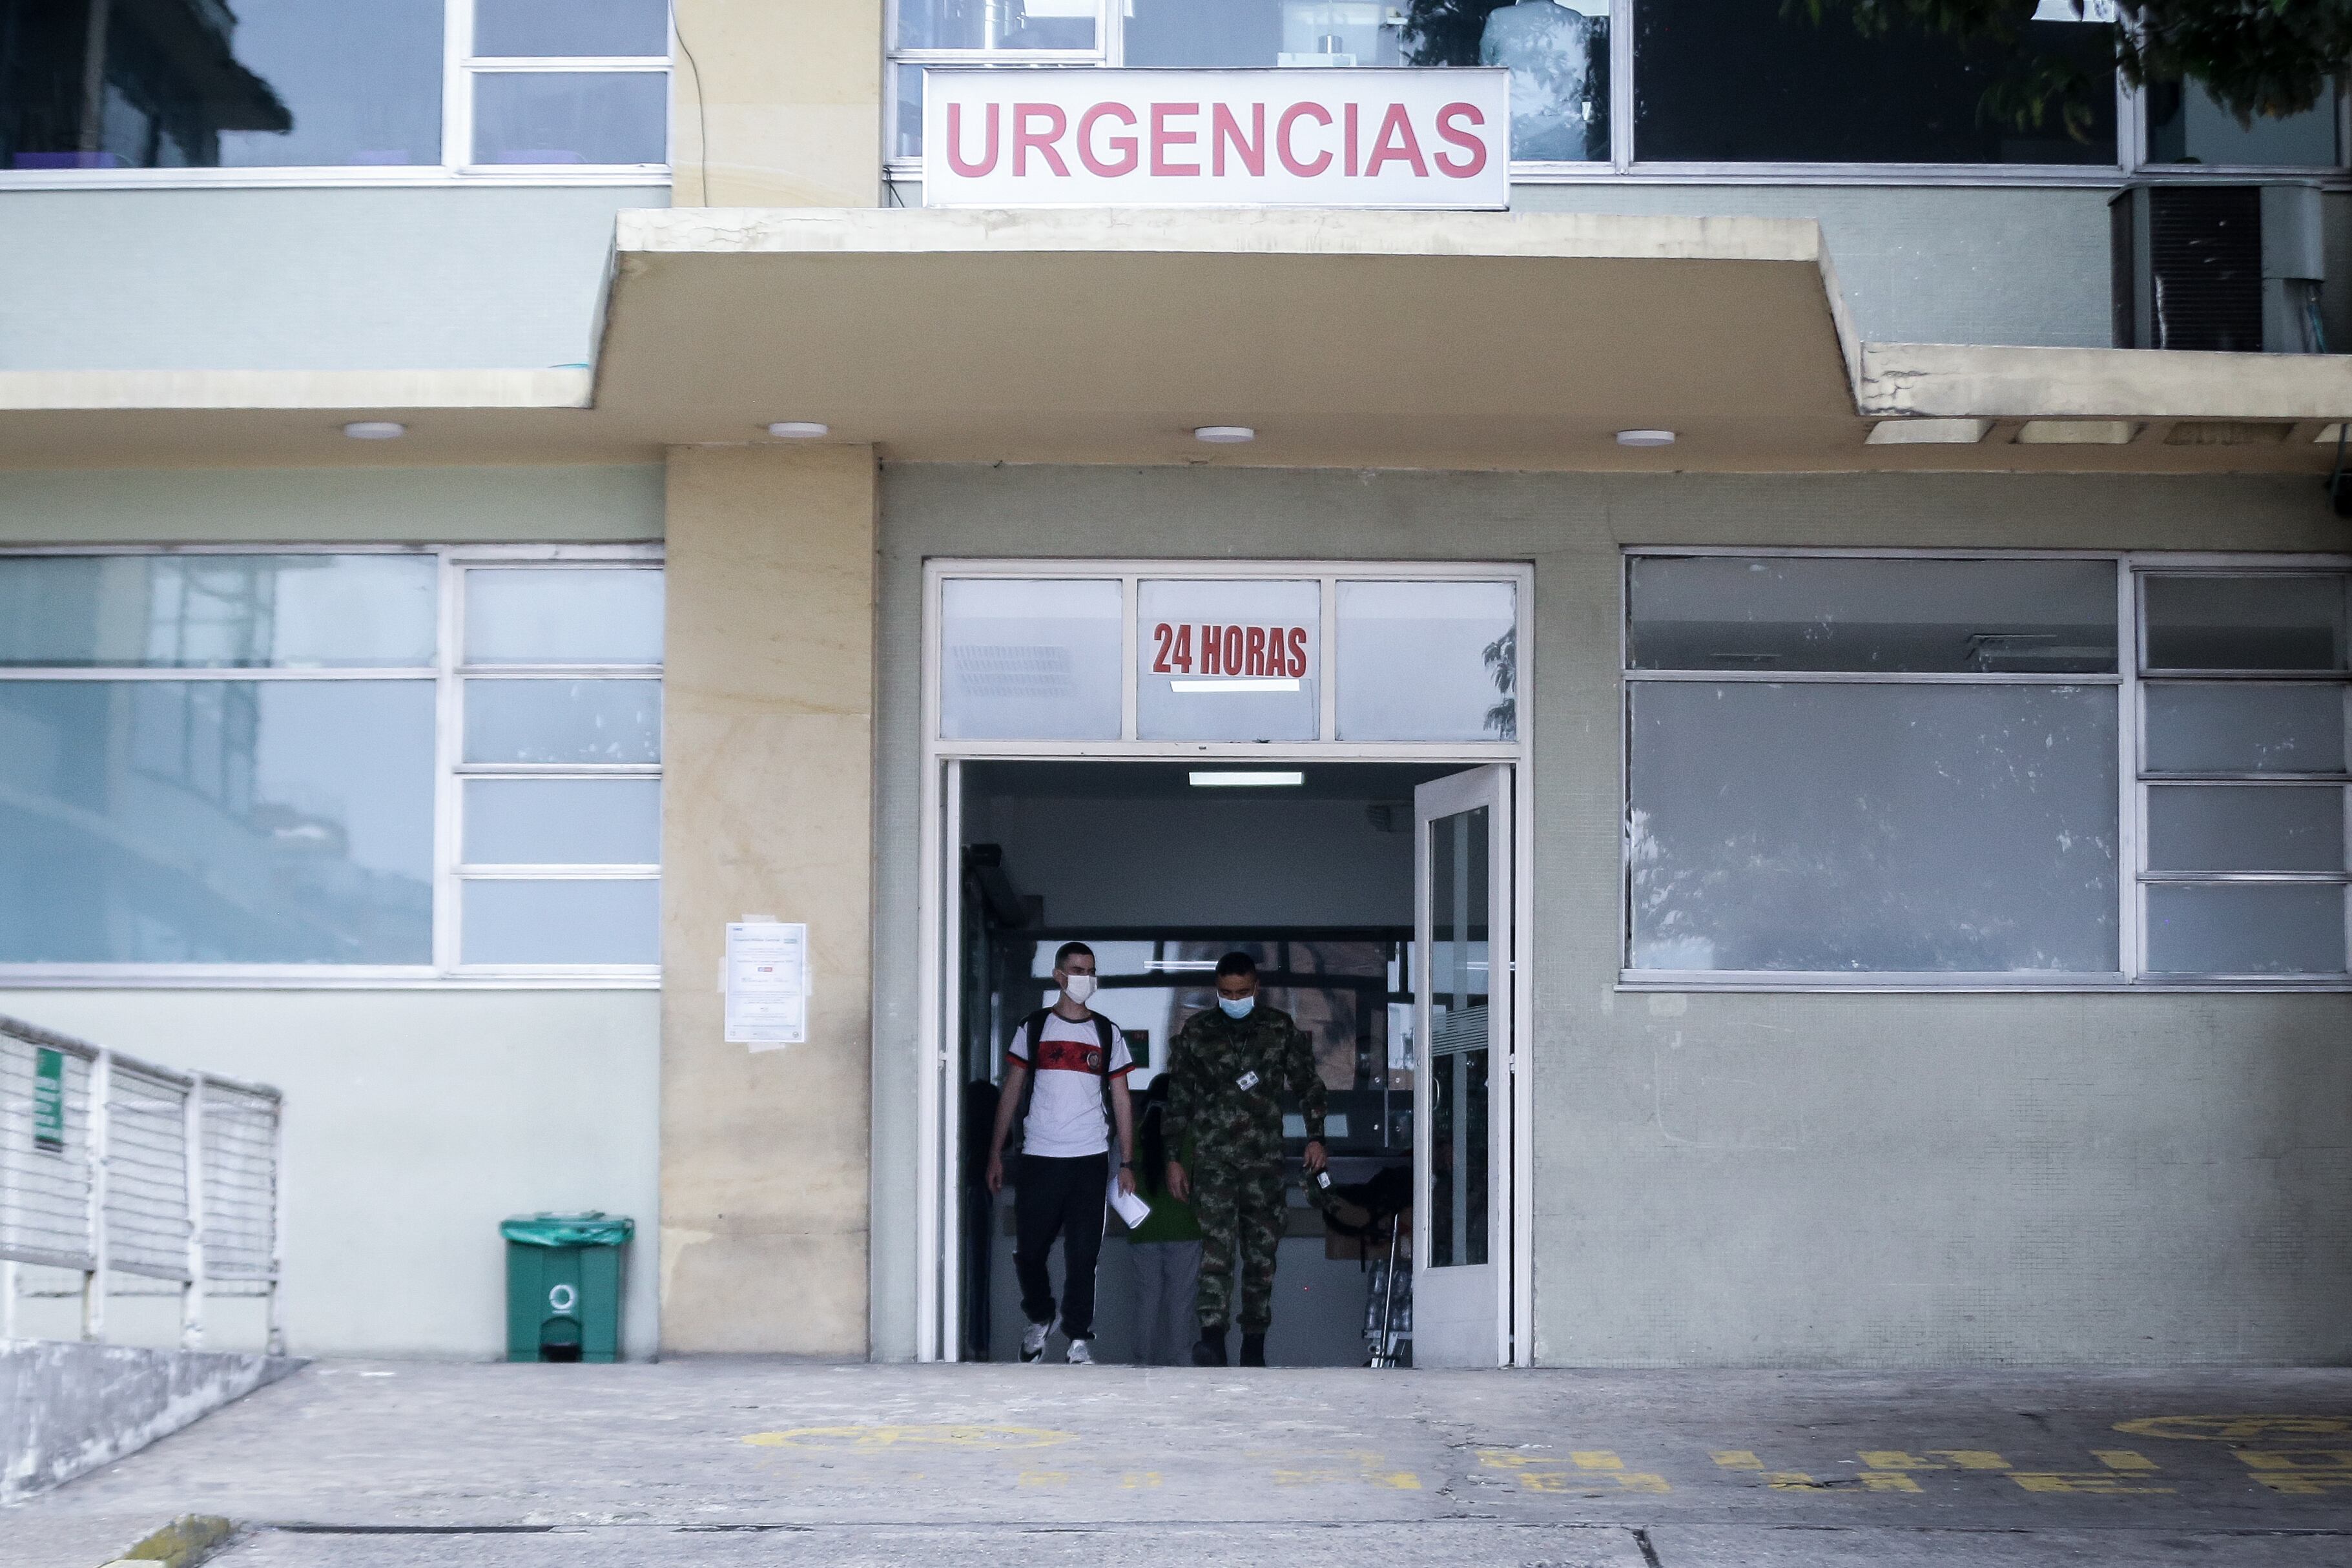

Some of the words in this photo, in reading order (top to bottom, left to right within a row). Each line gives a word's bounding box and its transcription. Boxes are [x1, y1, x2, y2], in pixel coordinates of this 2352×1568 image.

[945, 101, 1487, 178] URGENCIAS
[1153, 622, 1193, 674] 24
[1199, 623, 1308, 678] HORAS
